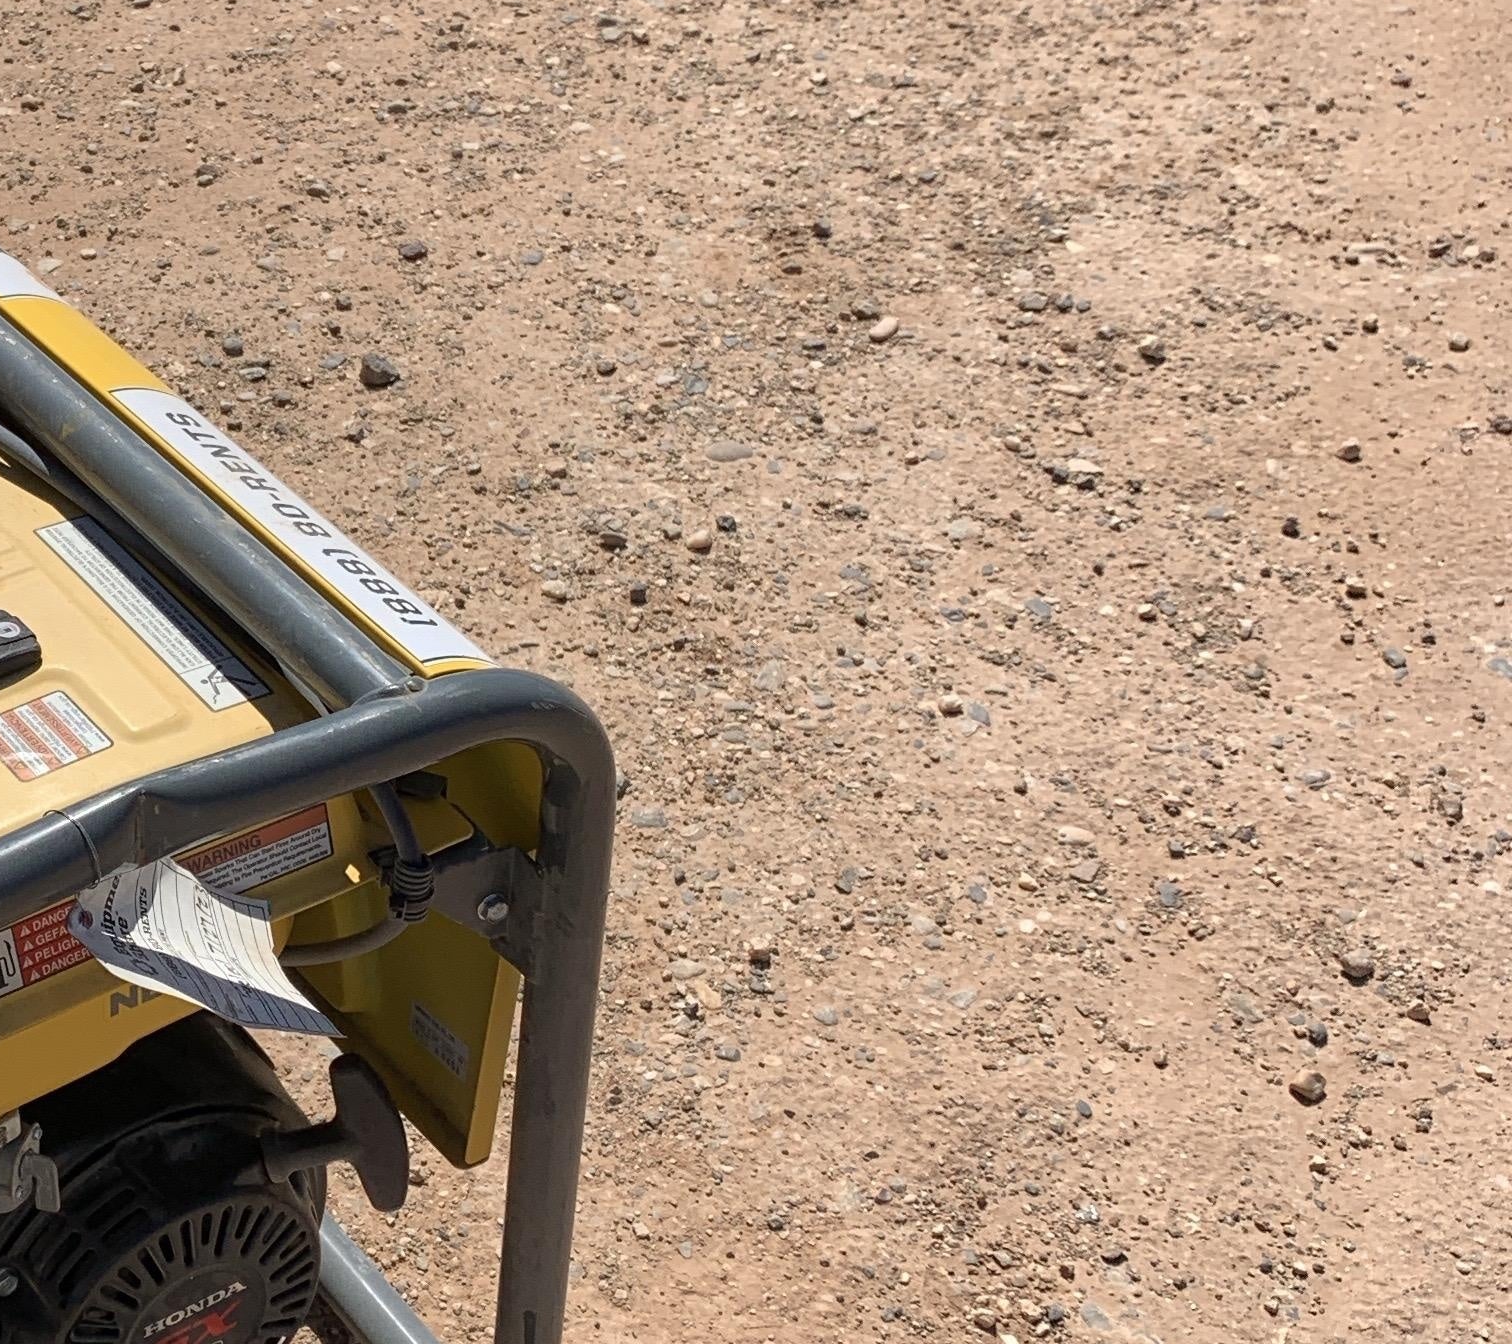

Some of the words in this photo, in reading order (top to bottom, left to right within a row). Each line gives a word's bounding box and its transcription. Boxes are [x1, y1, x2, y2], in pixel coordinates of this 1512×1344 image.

[166, 412, 331, 538] 80-RENTS
[323, 548, 438, 628] (888)
[186, 834, 262, 873] WARNING
[144, 1282, 247, 1338] HONDA
